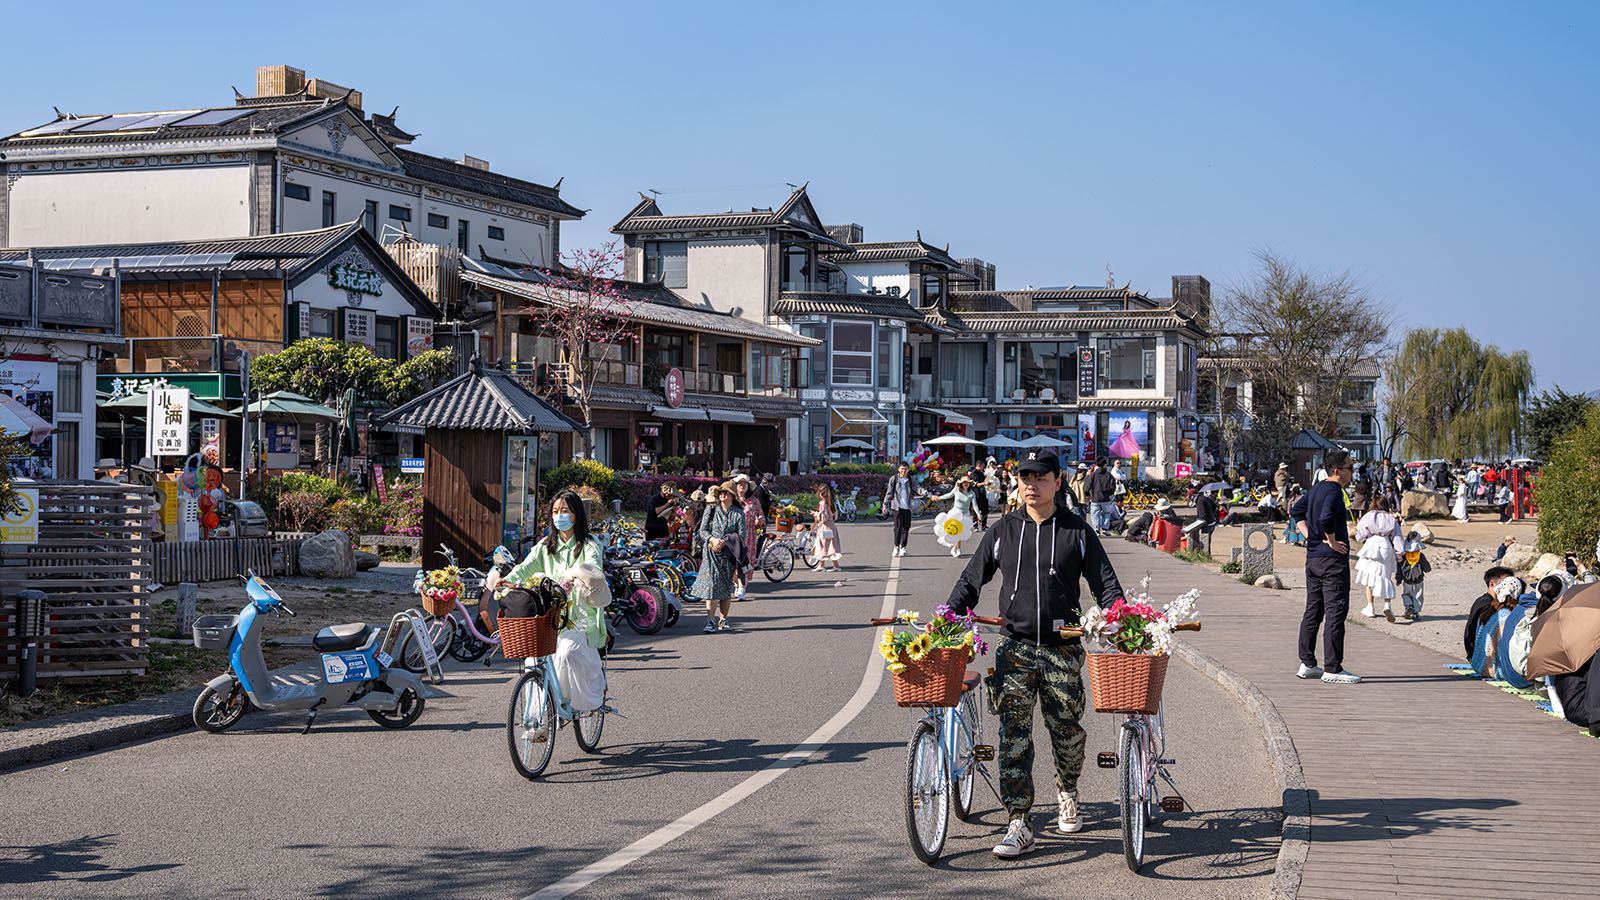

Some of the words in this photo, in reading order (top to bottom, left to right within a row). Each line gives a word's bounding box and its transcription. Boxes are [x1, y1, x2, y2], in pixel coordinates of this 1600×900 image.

[335, 266, 382, 294] 袁记云饺
[157, 391, 183, 425] 小满
[1028, 452, 1036, 460] R
[629, 570, 640, 579] 73
